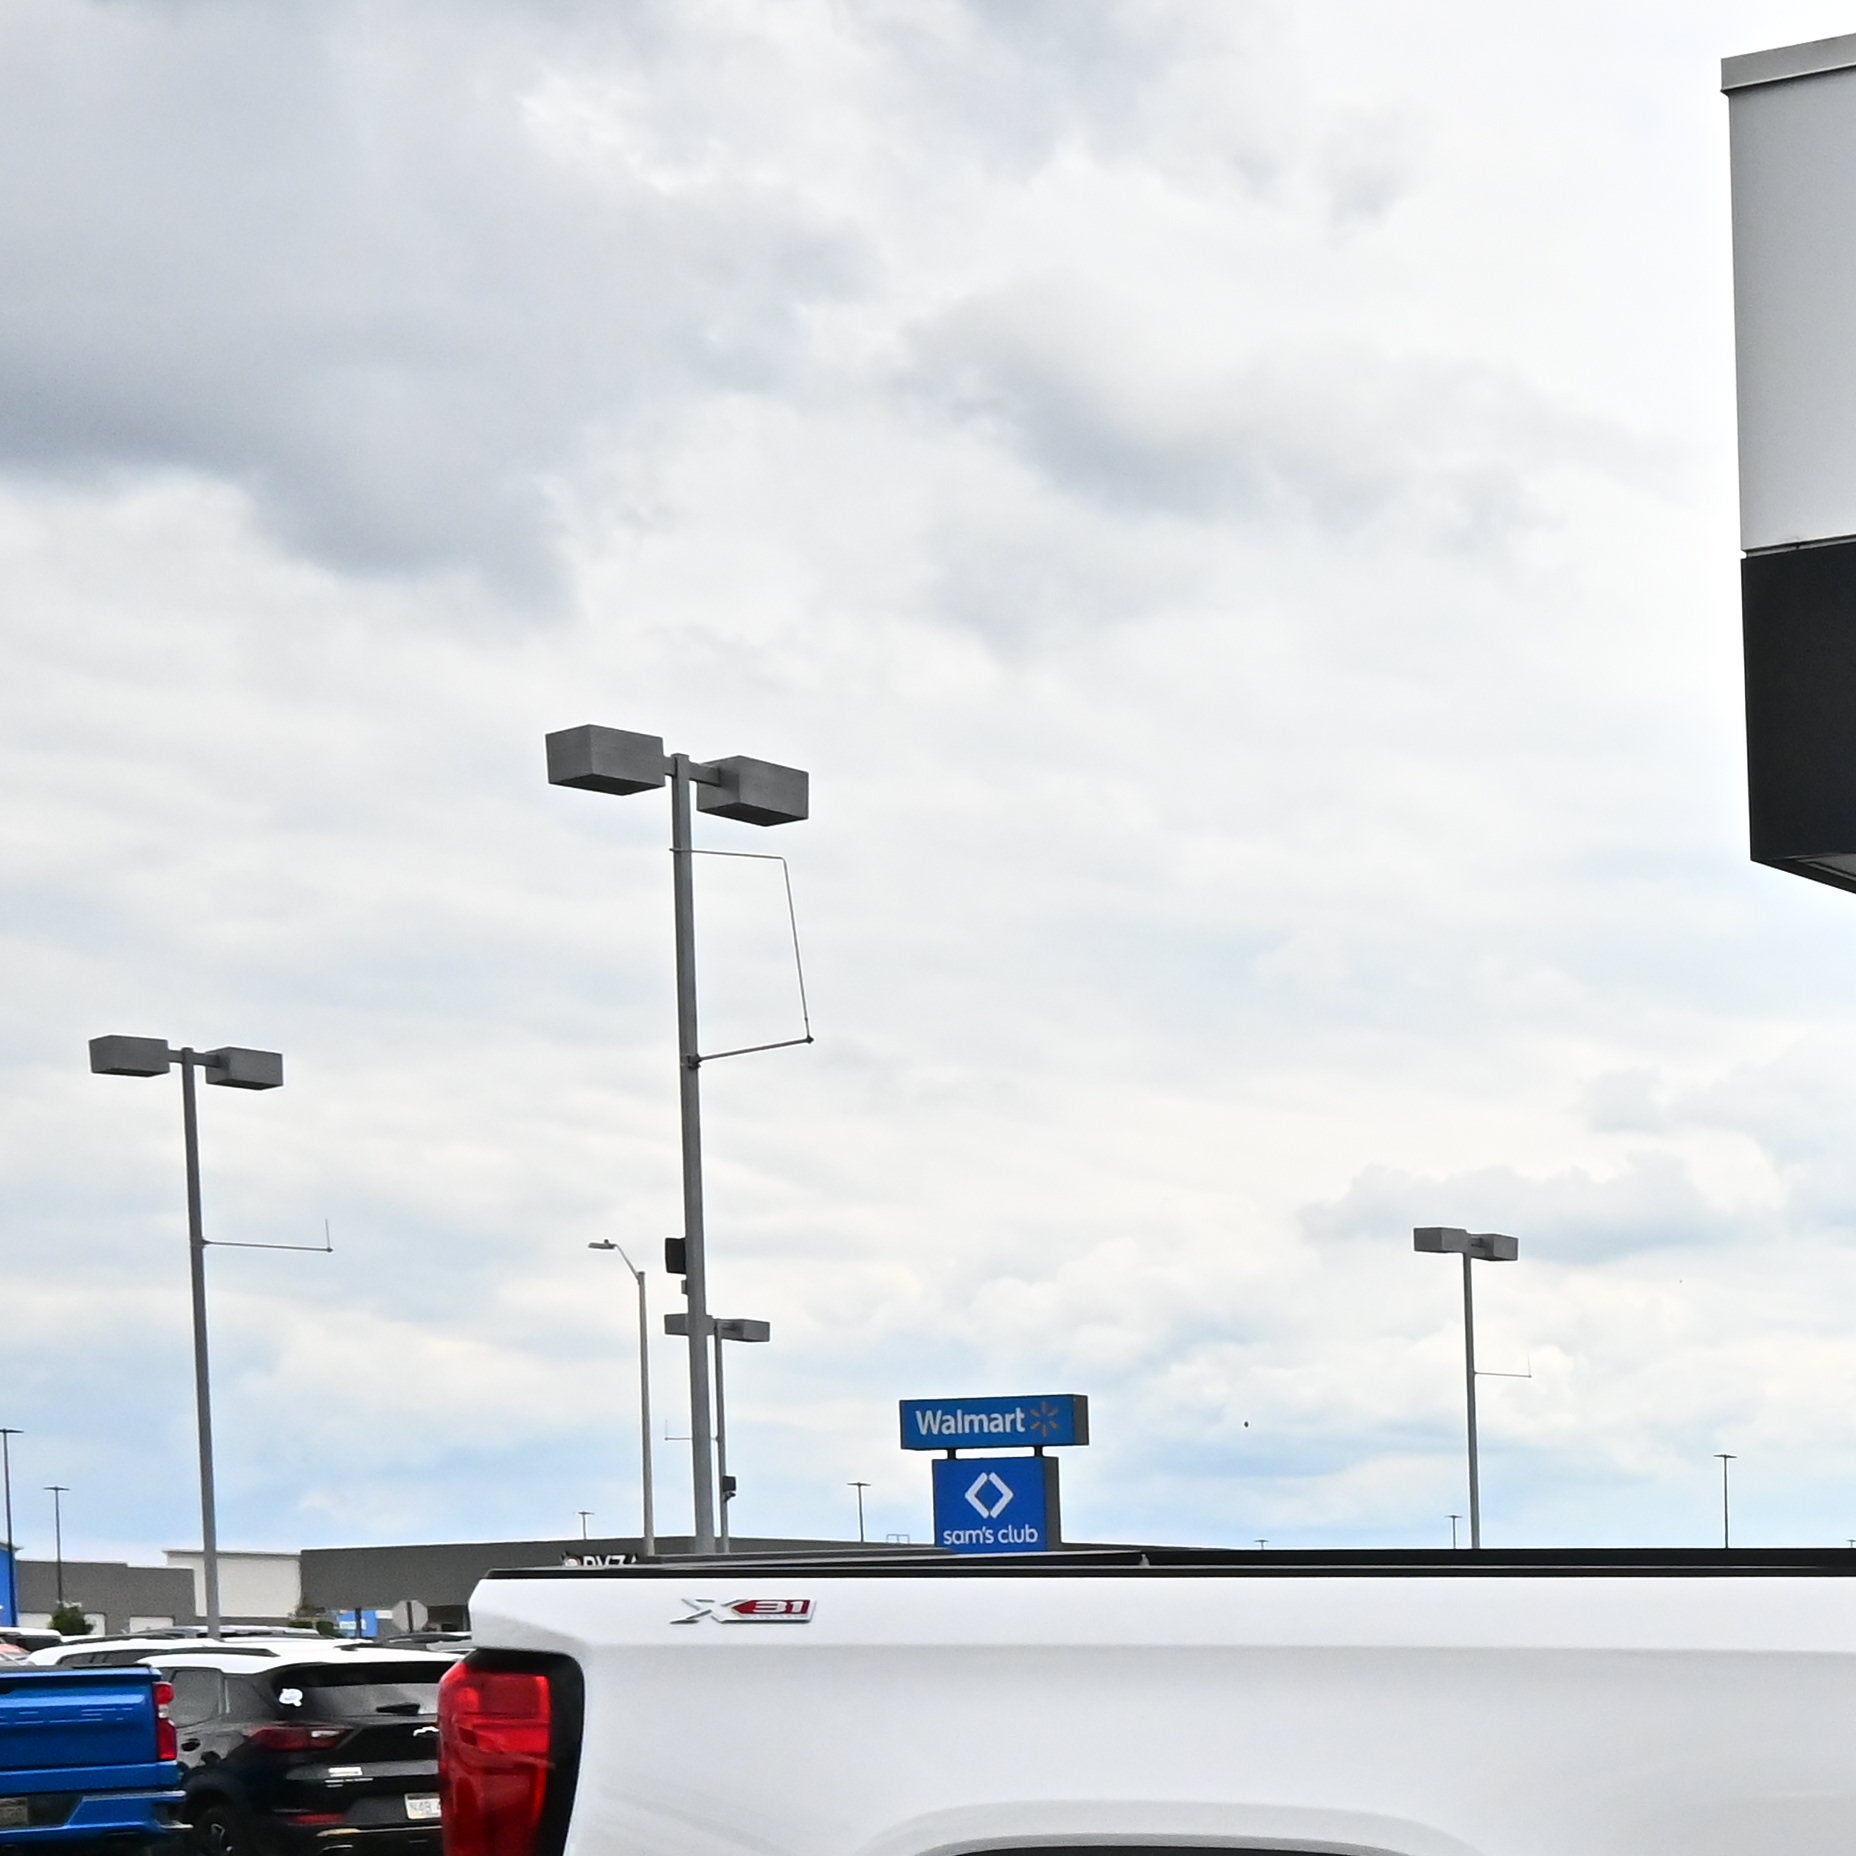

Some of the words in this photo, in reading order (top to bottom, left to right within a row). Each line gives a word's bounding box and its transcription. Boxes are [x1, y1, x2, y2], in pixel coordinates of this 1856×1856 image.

[915, 1407, 1026, 1436] Walmart
[943, 1526, 994, 1545] sam's
[997, 1524, 1039, 1544] club
